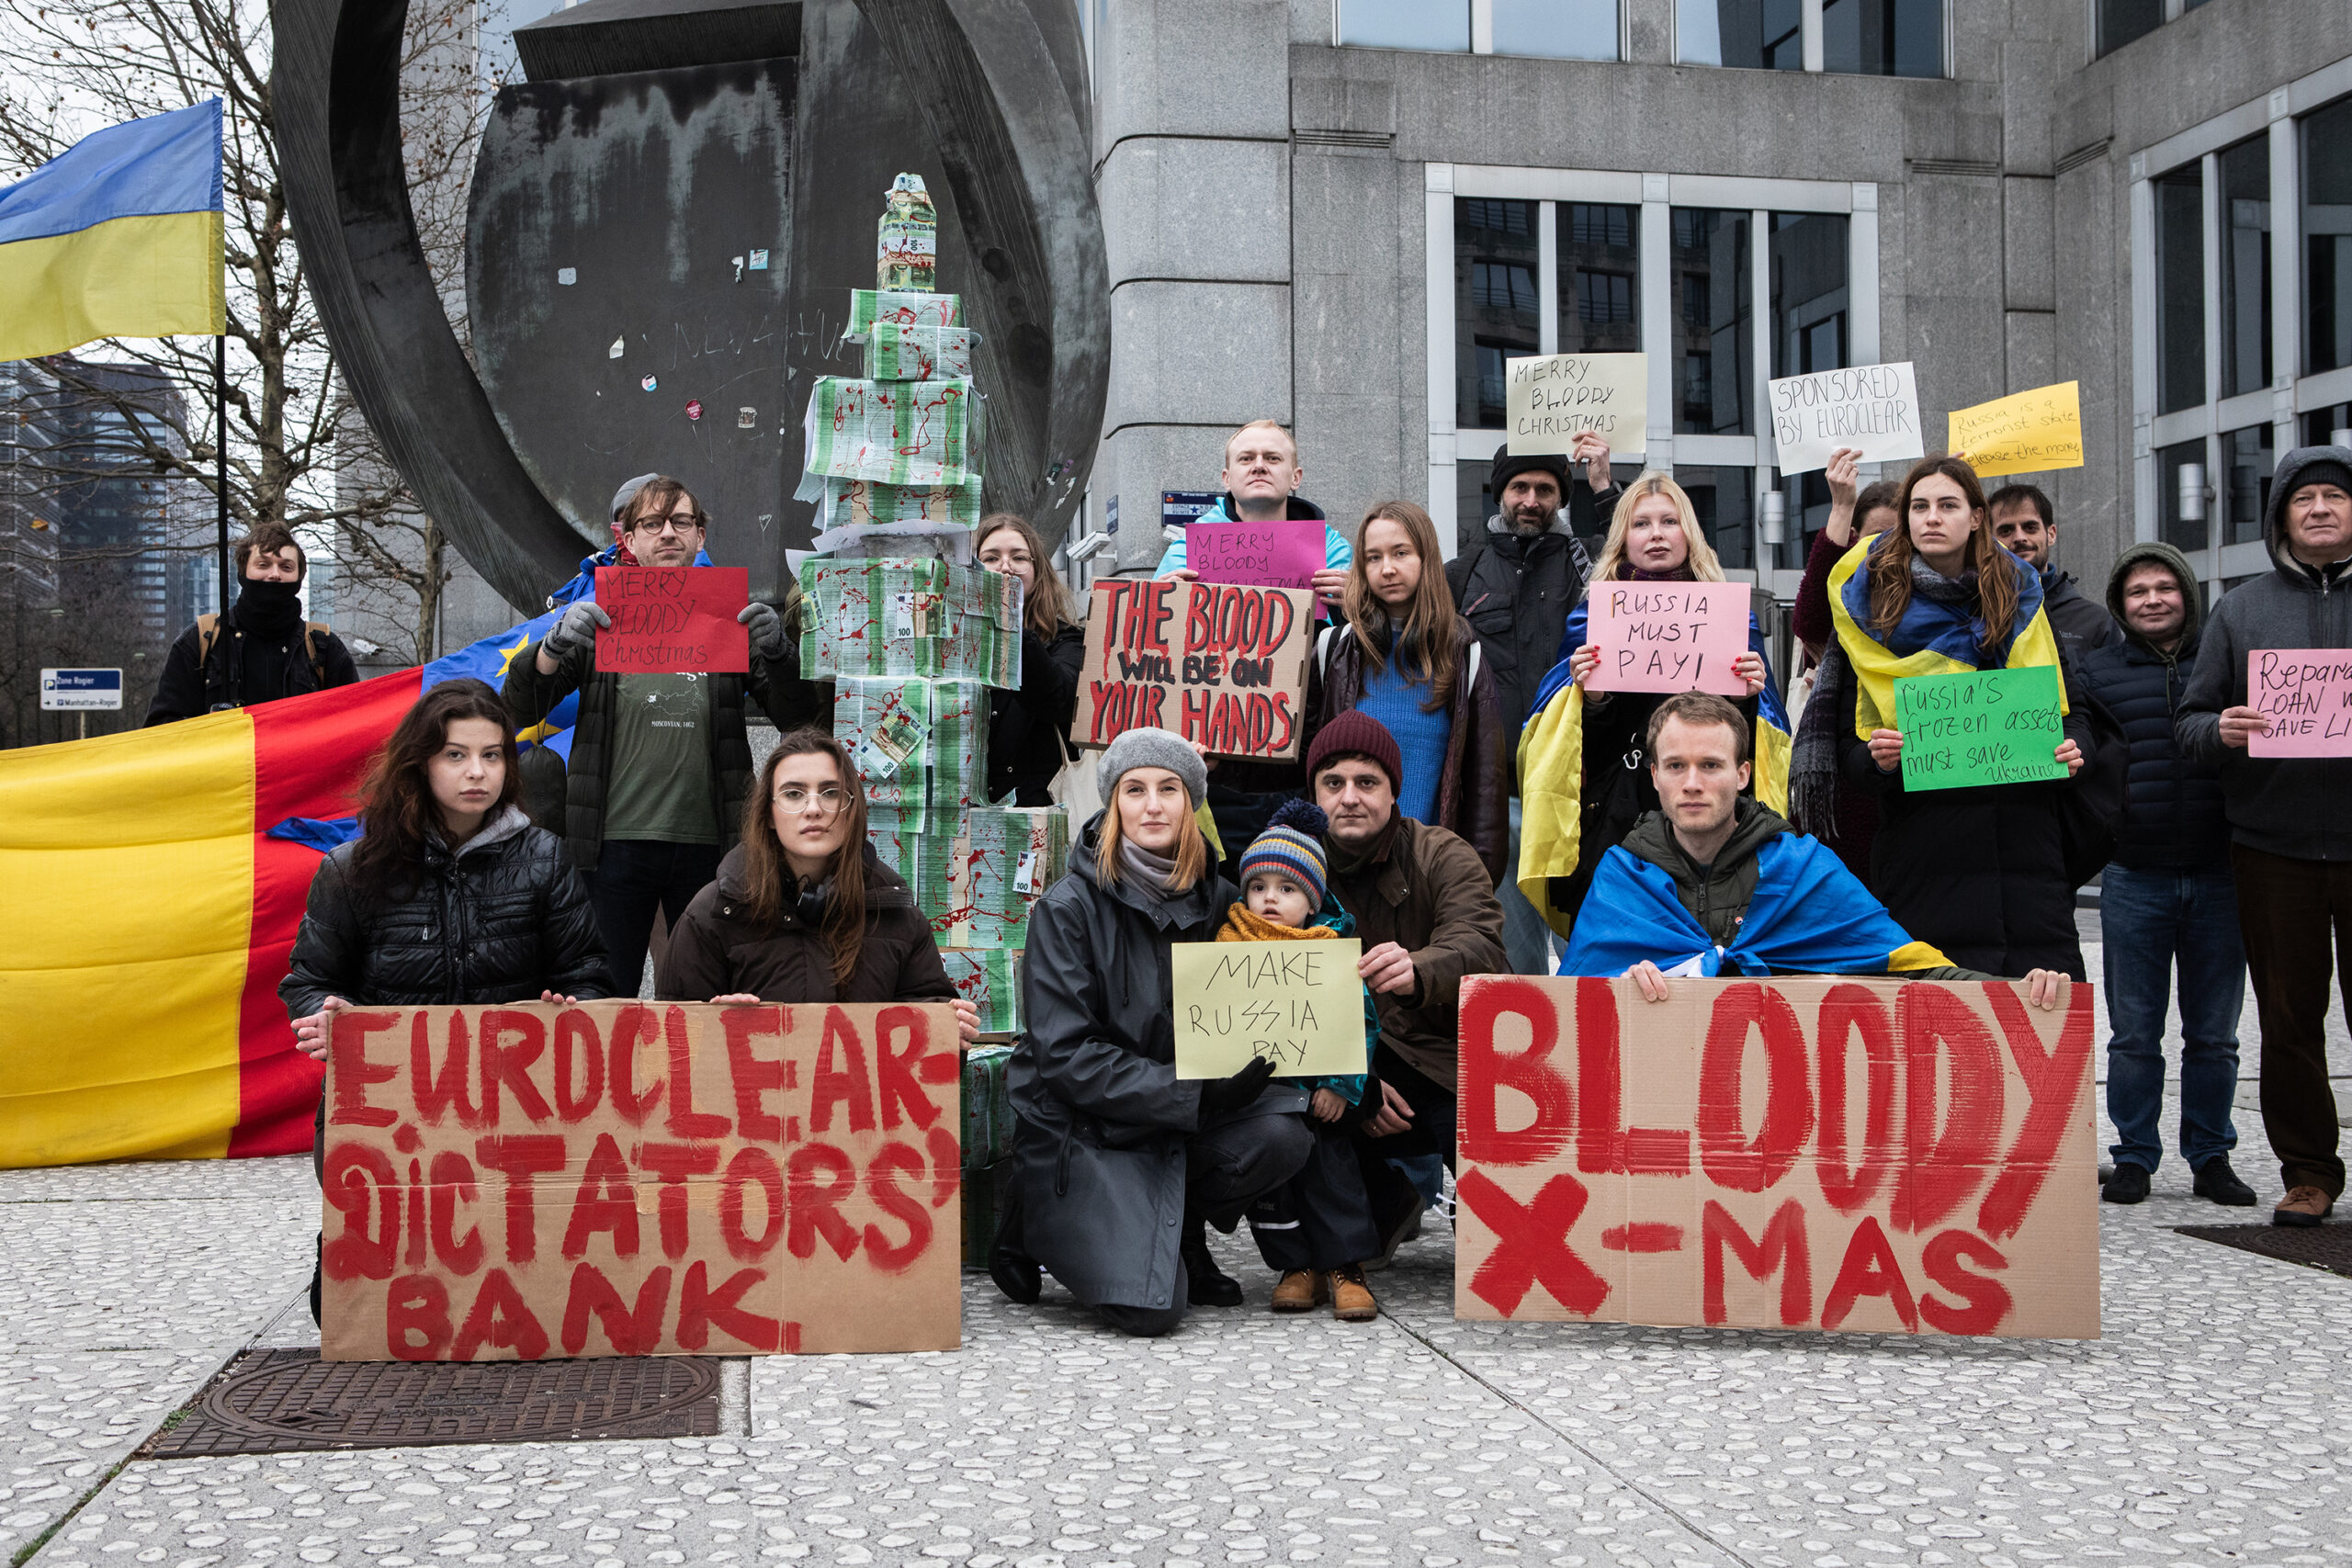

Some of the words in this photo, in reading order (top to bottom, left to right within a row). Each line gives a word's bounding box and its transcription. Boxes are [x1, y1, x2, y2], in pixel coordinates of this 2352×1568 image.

[1515, 359, 1590, 384] MERRY
[1532, 387, 1614, 411] BLOODY
[1778, 367, 1899, 412] SPONSORED
[1778, 412, 1802, 446] BY
[1817, 400, 1912, 438] EUROCLEAR
[1955, 410, 2009, 434] Russia
[2020, 402, 2033, 412] is
[2044, 400, 2055, 409] a
[2040, 412, 2077, 426] state
[1967, 449, 2012, 468] elease
[2014, 443, 2042, 459] the
[1194, 532, 1273, 555] MERRY
[1198, 555, 1269, 571] BLOODY
[604, 570, 687, 599] MERRY
[605, 599, 695, 636] BLOODY
[1611, 590, 1708, 618] RUSSIA
[898, 627, 911, 637] 100
[1093, 580, 1177, 663] THE
[1183, 582, 1294, 663] BLOOD
[1628, 622, 1708, 643] MUST
[600, 637, 707, 666] Christmas
[1117, 651, 1176, 685] WILL
[1182, 655, 1221, 687] BE
[1231, 657, 1274, 688] ON
[1619, 649, 1703, 690] PAY!
[2257, 685, 2325, 716] LOAN
[1091, 680, 1166, 744] YOUR
[1182, 688, 1294, 758] HANDS
[1905, 712, 1987, 752] frozen
[2005, 701, 2060, 733] assets
[882, 761, 894, 773] 100
[1906, 746, 1955, 776] must
[1966, 742, 2014, 769] save
[1016, 882, 1029, 891] 100
[1205, 951, 1323, 990] MAKE
[1189, 998, 1318, 1036] RUSSIA
[1252, 1039, 1307, 1066] PAY
[1457, 976, 2095, 1243] BLOODY
[1455, 1165, 2014, 1337] X-MAS
[387, 1259, 802, 1362] BANK
